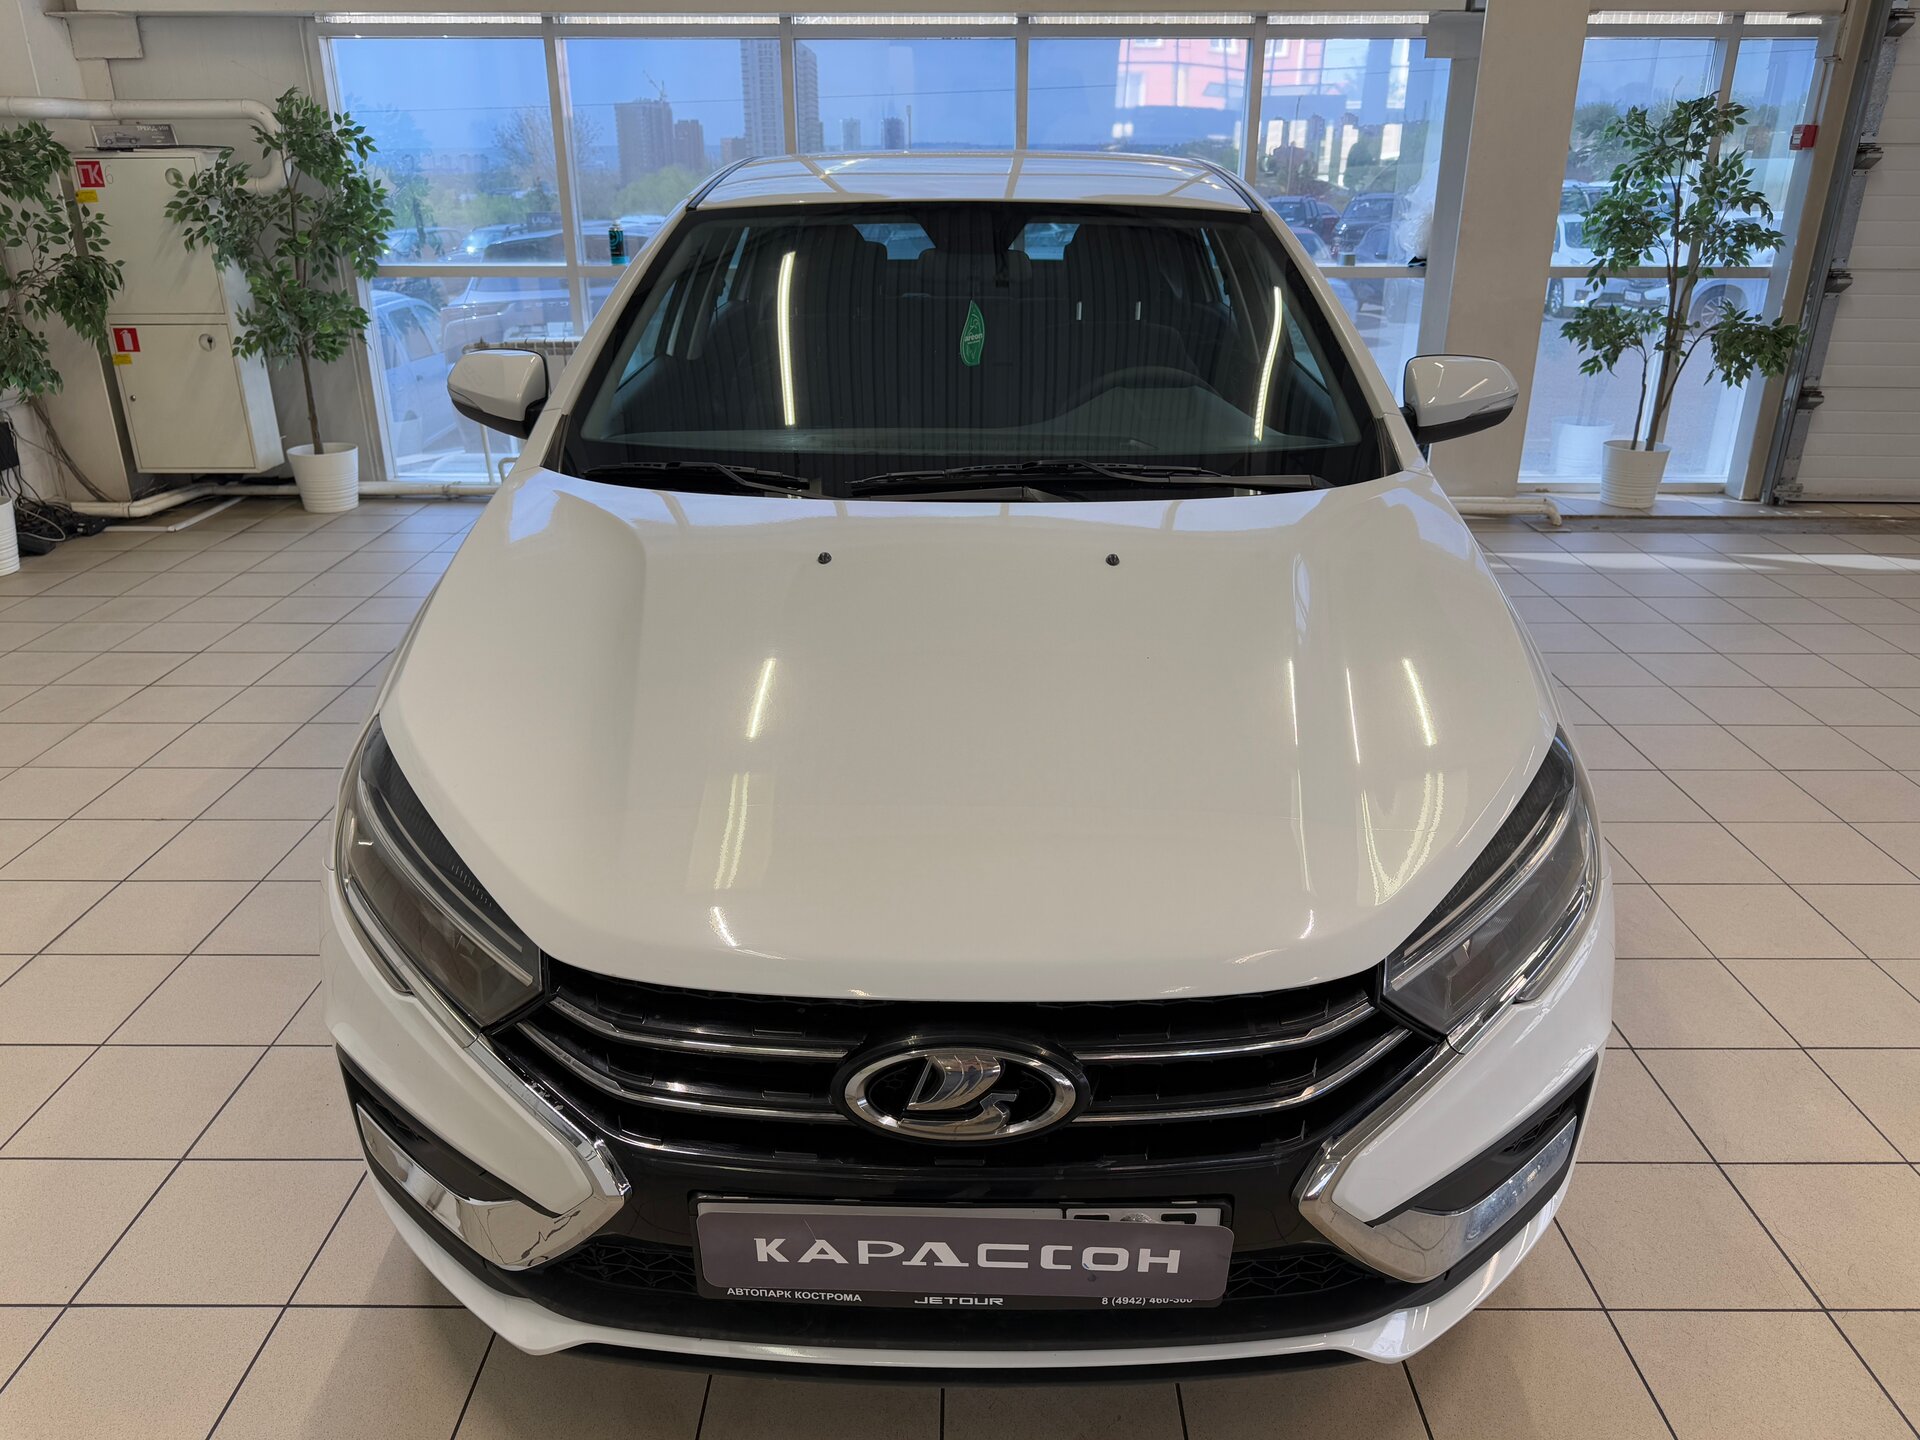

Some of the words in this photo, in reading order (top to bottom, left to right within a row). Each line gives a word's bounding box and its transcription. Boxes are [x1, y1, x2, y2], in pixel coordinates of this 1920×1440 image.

[78, 164, 103, 184] ПК
[753, 1237, 1181, 1274] КАРАССОН
[726, 1287, 792, 1299] АВТОПАРК
[794, 1290, 862, 1302] КОСТРОМА
[914, 1296, 1004, 1306] JETOUR
[1101, 1297, 1108, 1305] 8
[1111, 1296, 1146, 1307] (4942)
